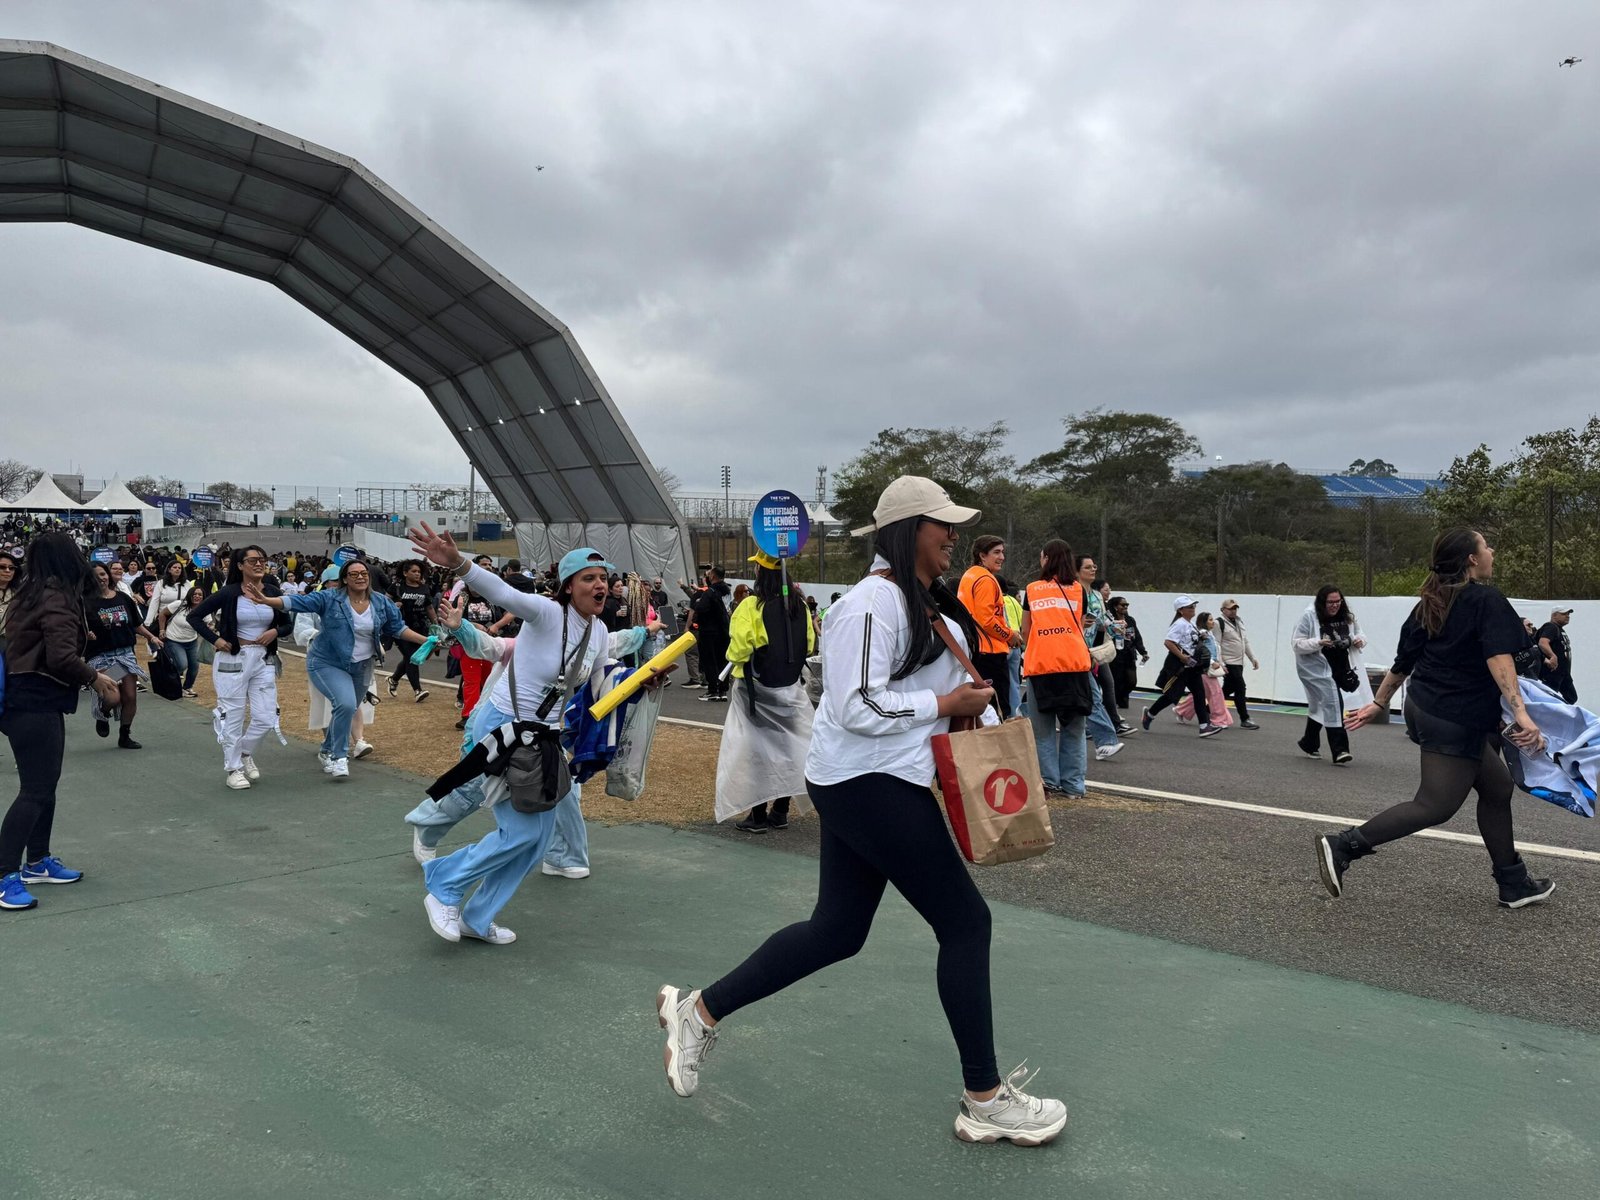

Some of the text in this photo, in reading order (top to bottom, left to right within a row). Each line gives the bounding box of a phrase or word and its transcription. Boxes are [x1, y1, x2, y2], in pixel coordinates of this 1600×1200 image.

[763, 506, 798, 516] IDENTIFICAÇÃO
[763, 516, 799, 526] DE MENORES
